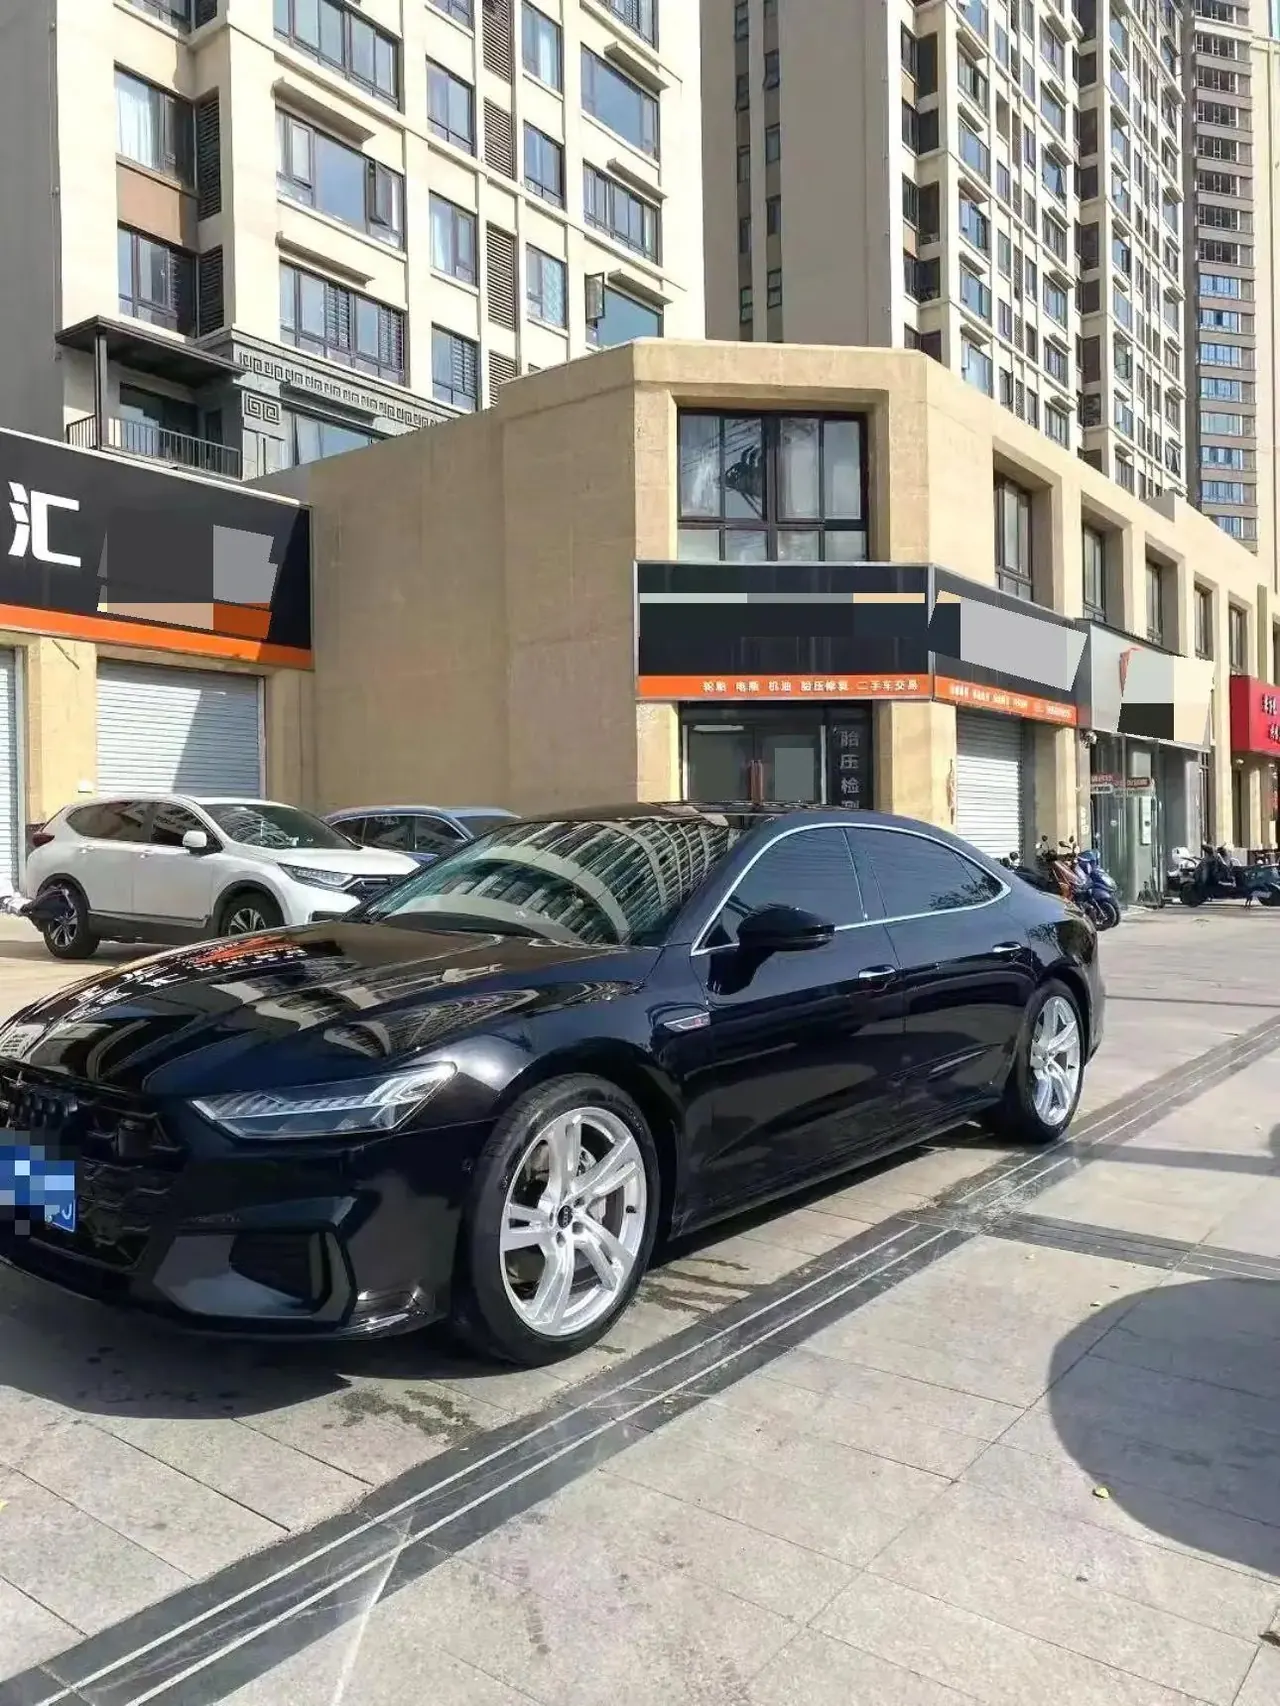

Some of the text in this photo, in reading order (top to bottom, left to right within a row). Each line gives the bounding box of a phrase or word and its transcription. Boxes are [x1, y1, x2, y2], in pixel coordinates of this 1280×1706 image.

[8, 481, 82, 567] 汇
[702, 681, 727, 692] 轮胎
[768, 681, 792, 692] 机油
[857, 679, 918, 692] 二手车交易
